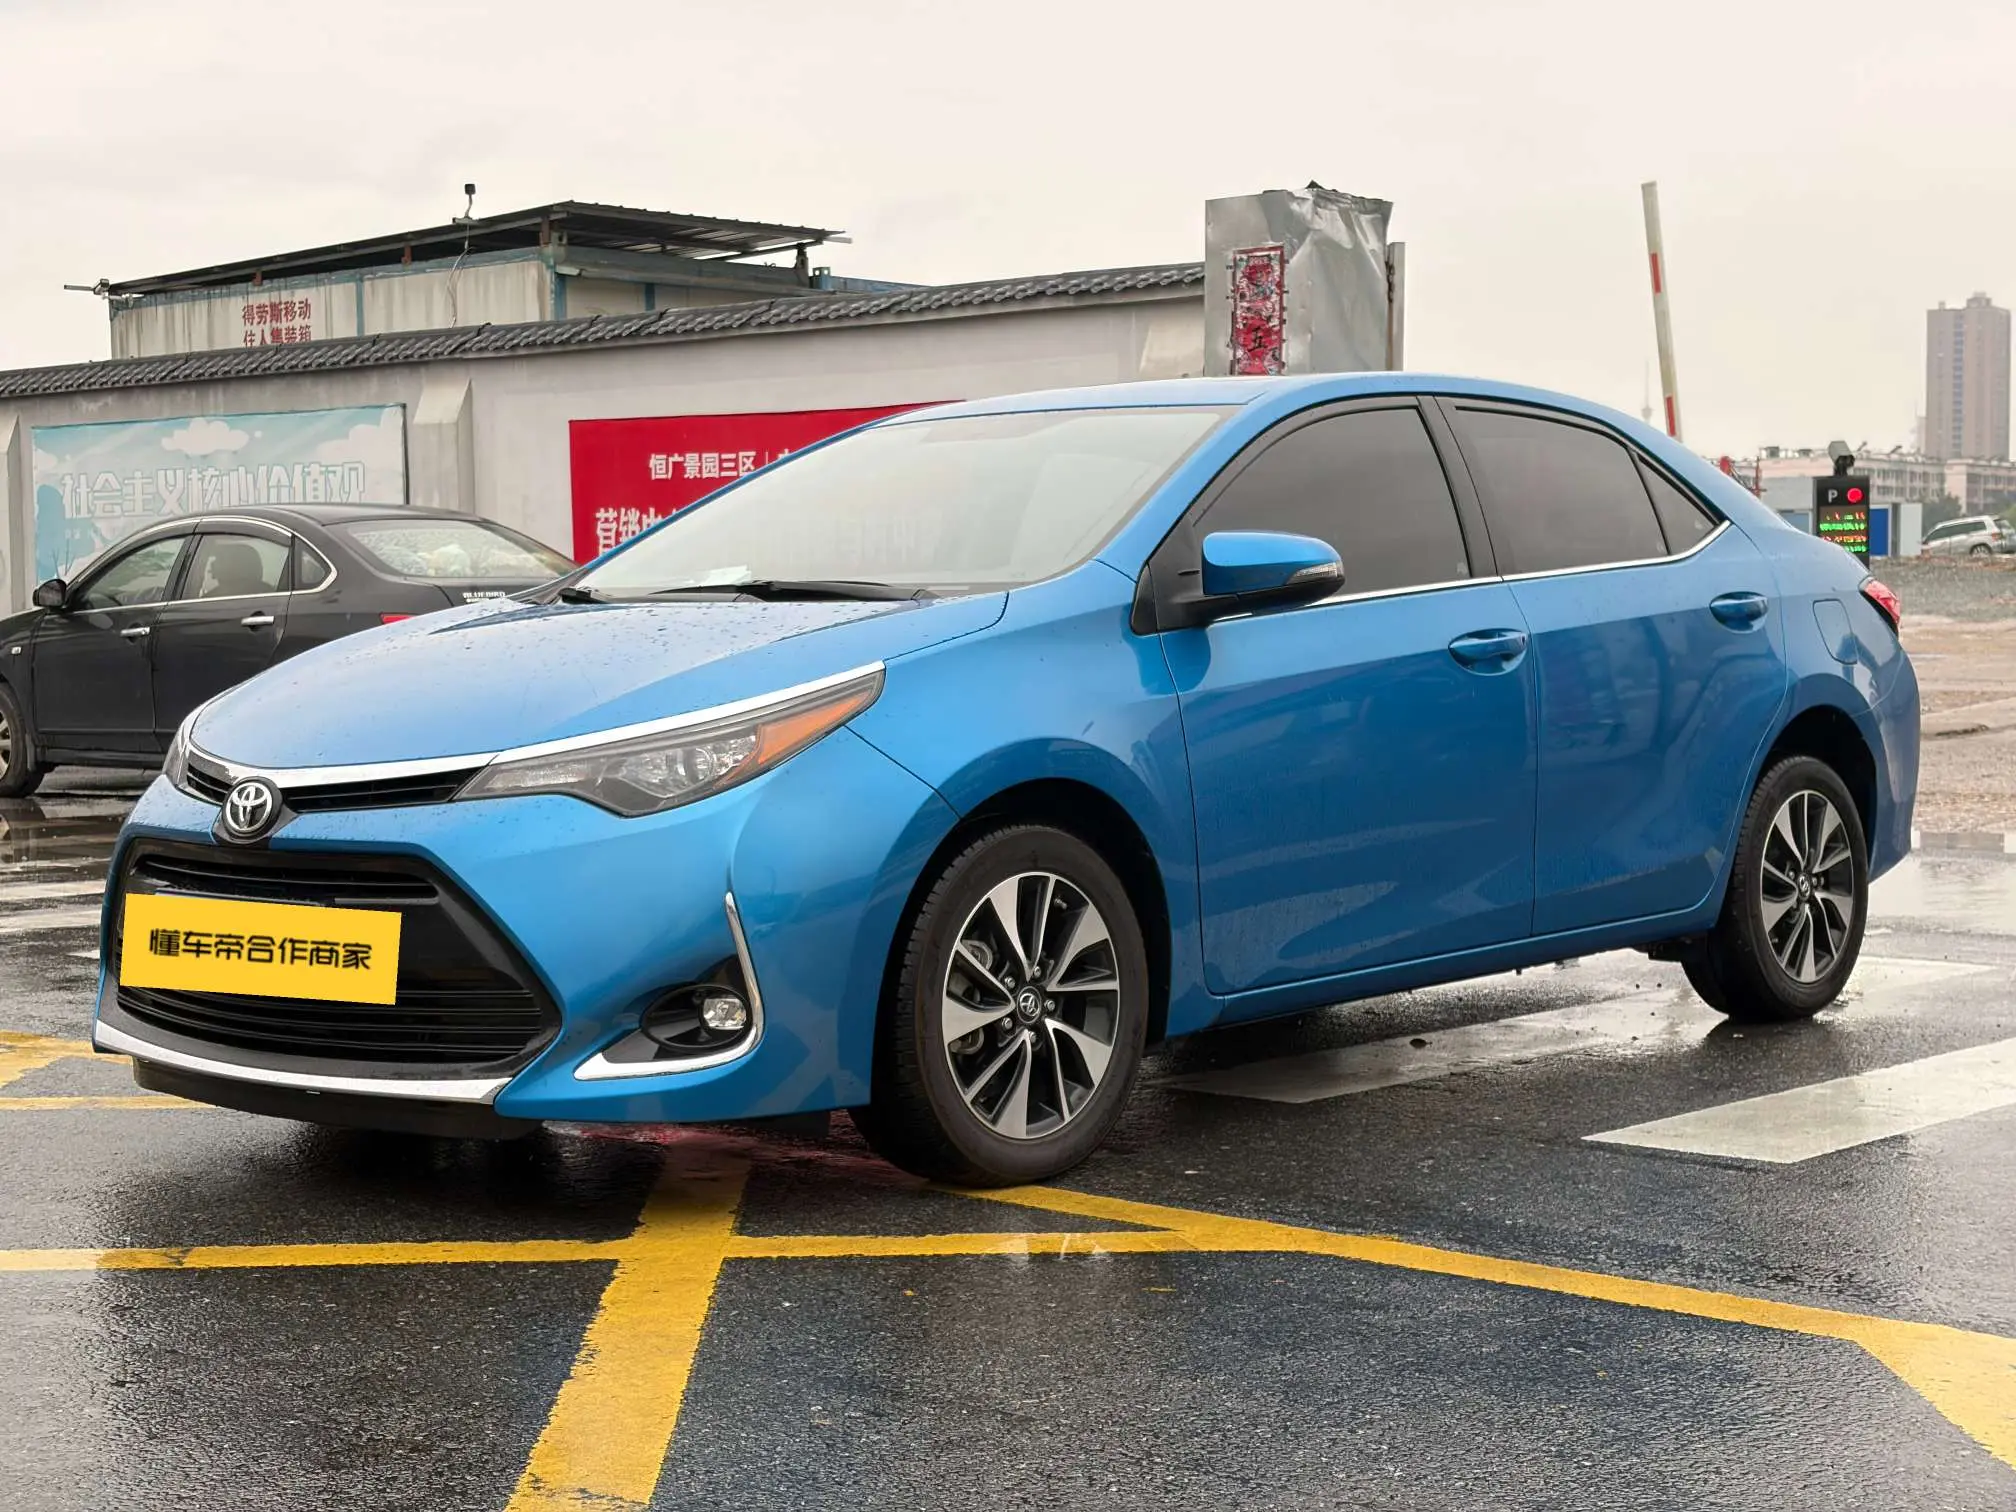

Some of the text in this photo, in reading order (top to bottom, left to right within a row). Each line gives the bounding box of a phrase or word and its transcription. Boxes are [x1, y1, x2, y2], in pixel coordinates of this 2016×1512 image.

[242, 298, 312, 325] 得劳斯移动
[649, 451, 756, 480] 恒广景园三区
[61, 461, 365, 518] 社会主义核心价值观
